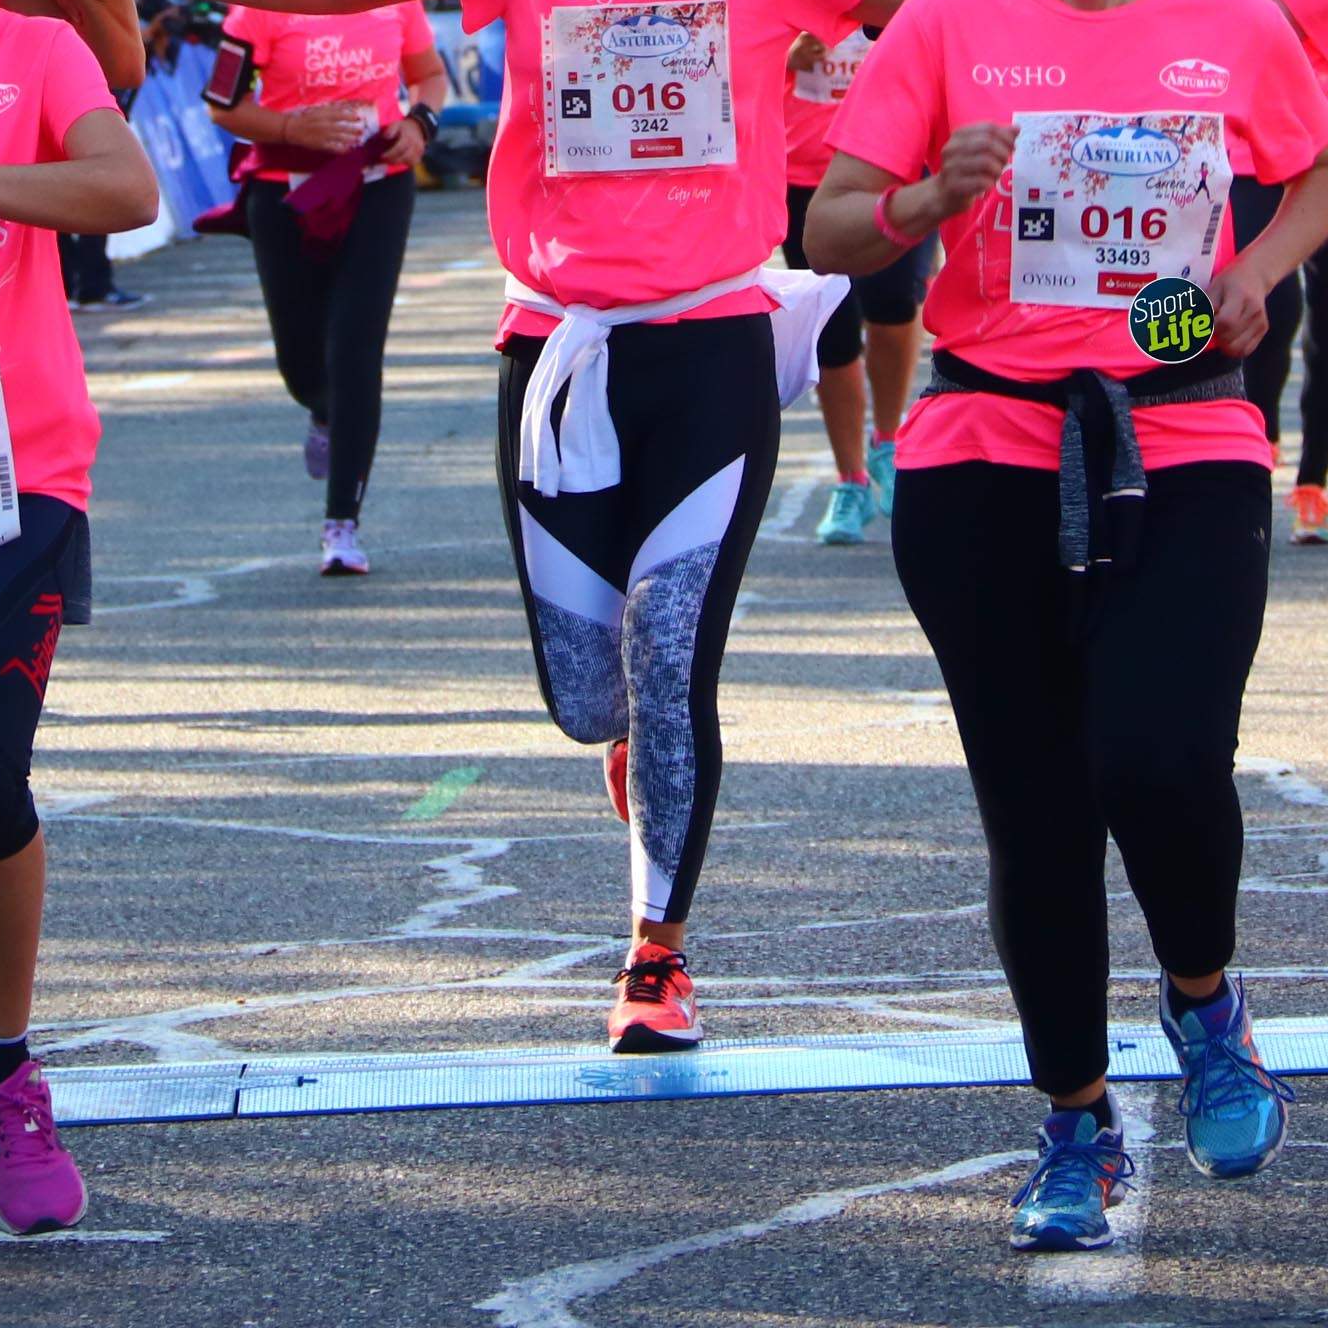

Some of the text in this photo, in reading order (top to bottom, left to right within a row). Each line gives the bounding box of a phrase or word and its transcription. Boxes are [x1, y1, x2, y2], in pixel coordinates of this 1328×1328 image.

[306, 35, 343, 54] HOY
[608, 31, 684, 48] ASTURIANA
[305, 48, 372, 71] GANAN
[972, 63, 1066, 87] OYSHO
[612, 81, 686, 113] 016
[631, 118, 670, 133] 3242
[567, 144, 613, 157] OYSHO
[1080, 142, 1173, 164] ASTURIANA
[1080, 205, 1168, 240] 016
[1095, 247, 1150, 265] 33493
[1023, 273, 1076, 287] OYSHO
